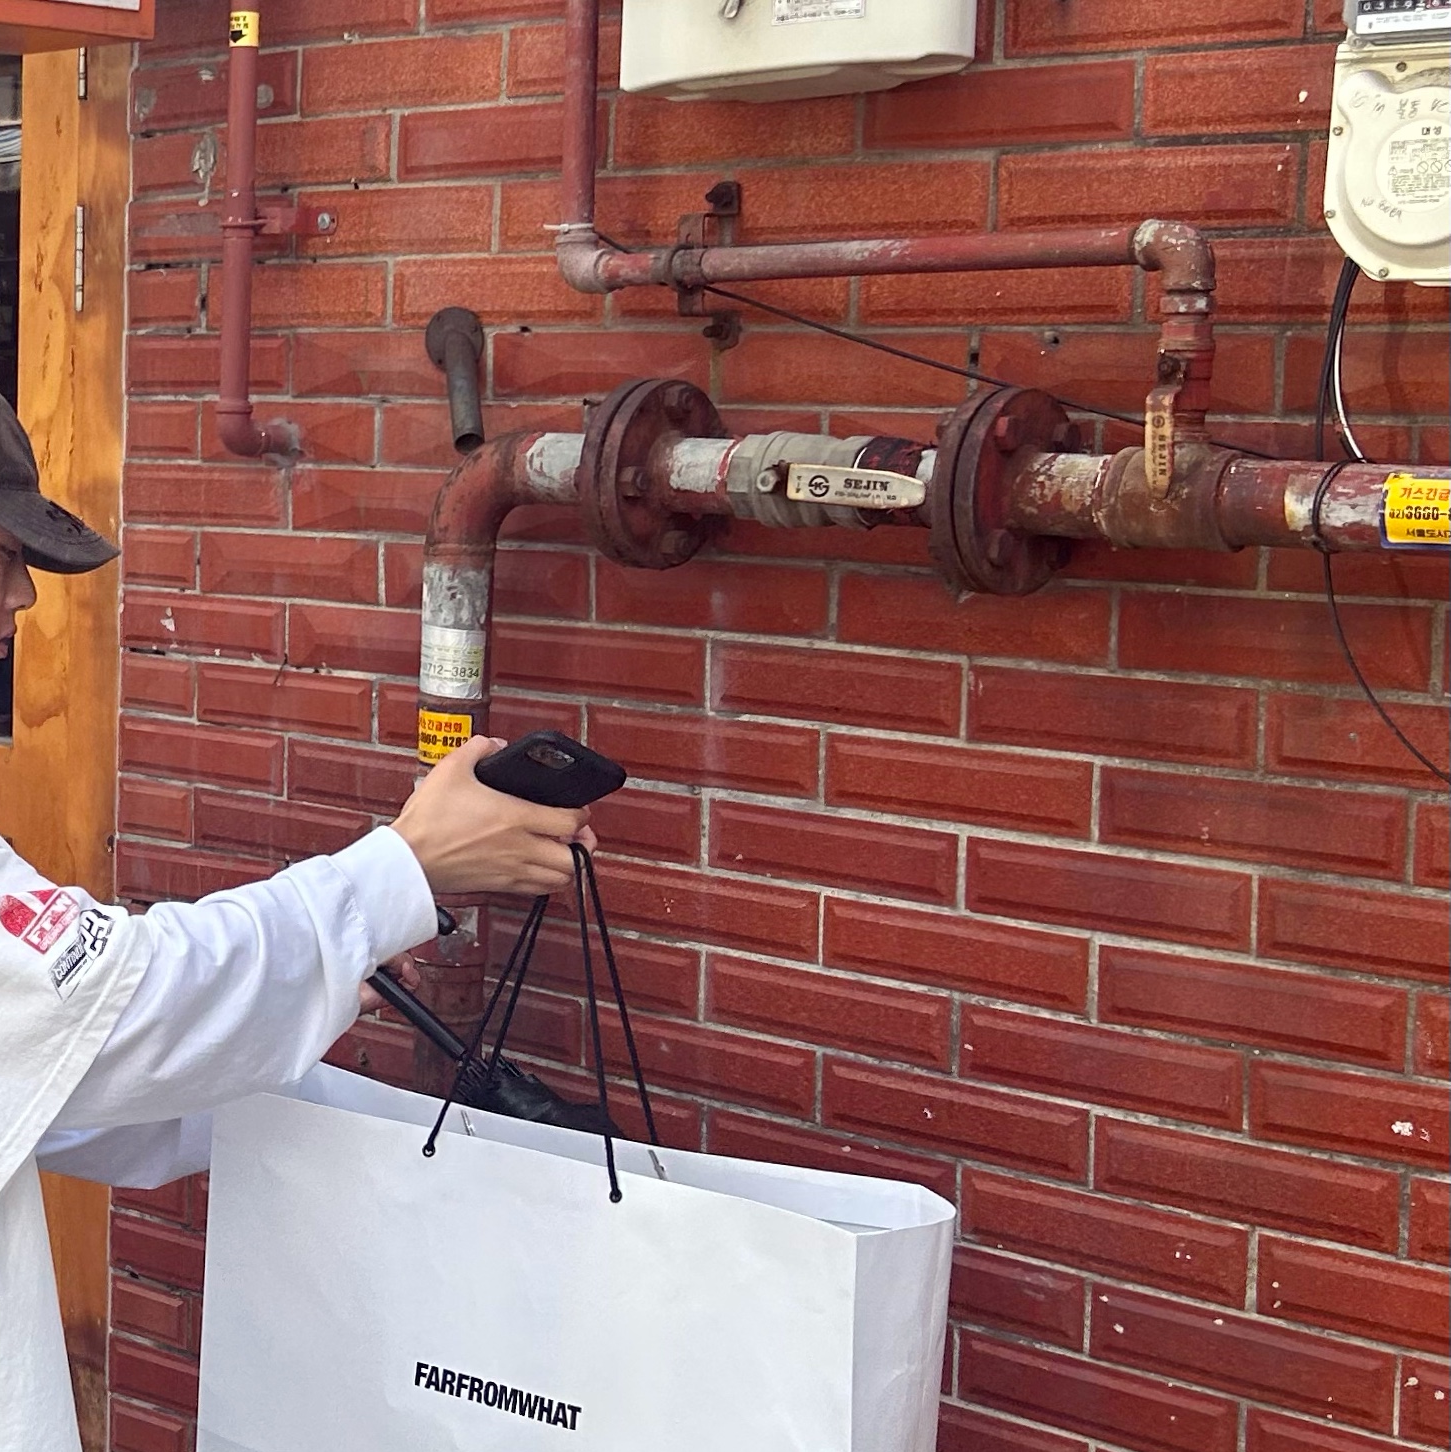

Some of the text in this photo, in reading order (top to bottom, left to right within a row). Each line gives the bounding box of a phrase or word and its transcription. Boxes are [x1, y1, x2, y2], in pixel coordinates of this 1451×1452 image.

[843, 478, 890, 491] SEJIN
[1389, 505, 1451, 521] 02)3660-
[414, 1361, 582, 1430] FARFROMWHAT
